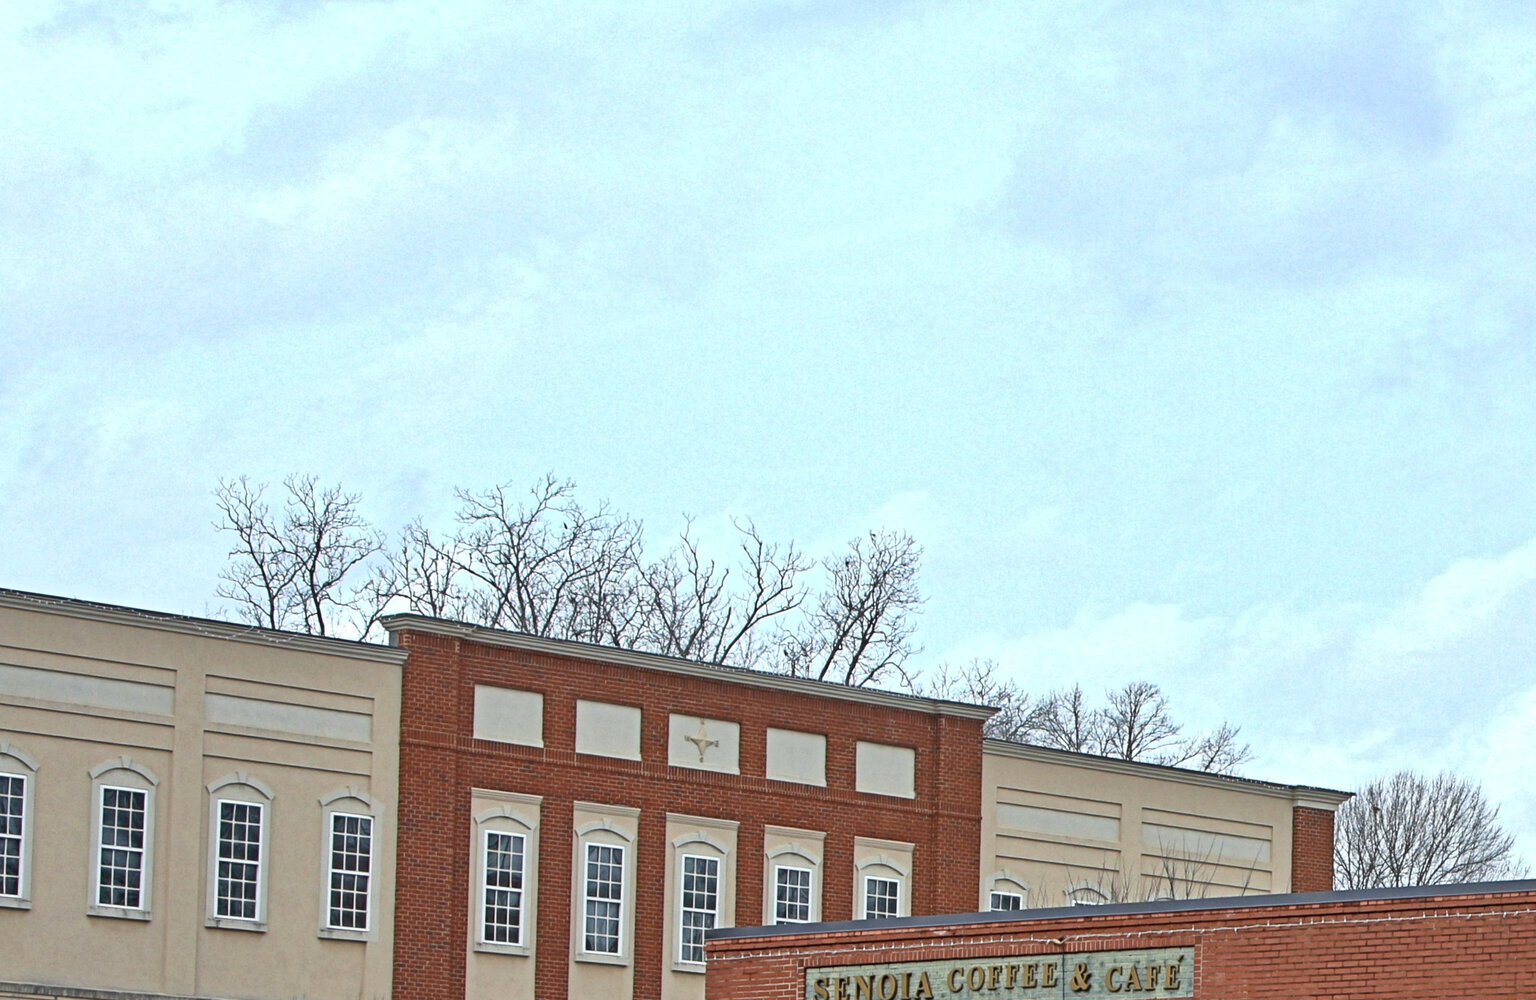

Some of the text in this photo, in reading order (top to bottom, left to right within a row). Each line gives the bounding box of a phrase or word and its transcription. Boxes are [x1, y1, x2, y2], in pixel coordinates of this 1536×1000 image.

[947, 962, 1058, 992] COFFEE
[1070, 962, 1091, 992] &
[1105, 954, 1184, 991] CAFÉ
